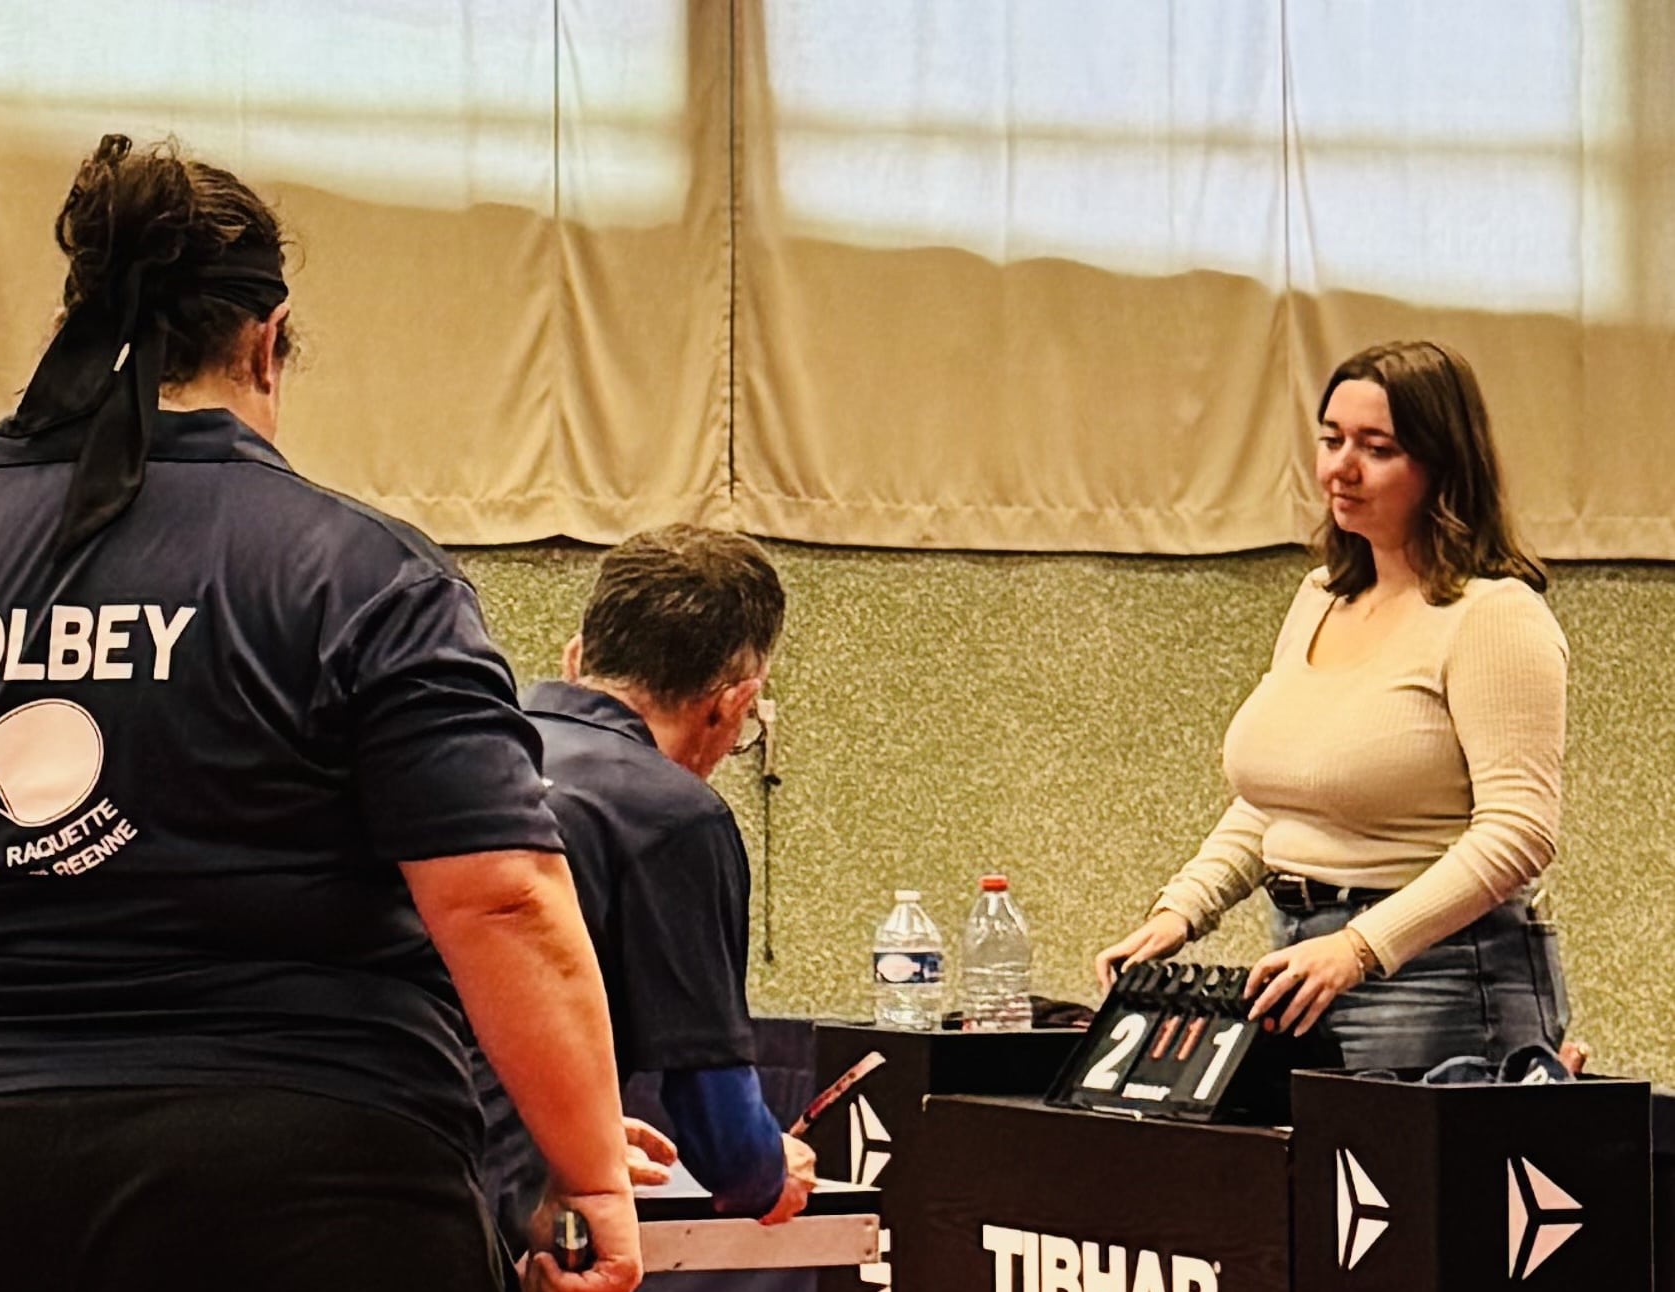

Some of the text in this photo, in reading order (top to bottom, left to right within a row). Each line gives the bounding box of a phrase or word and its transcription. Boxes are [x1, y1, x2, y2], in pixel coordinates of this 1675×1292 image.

[6, 797, 119, 868] RAQUETTE
[1082, 1013, 1148, 1090] 2
[1193, 1022, 1245, 1100] 1
